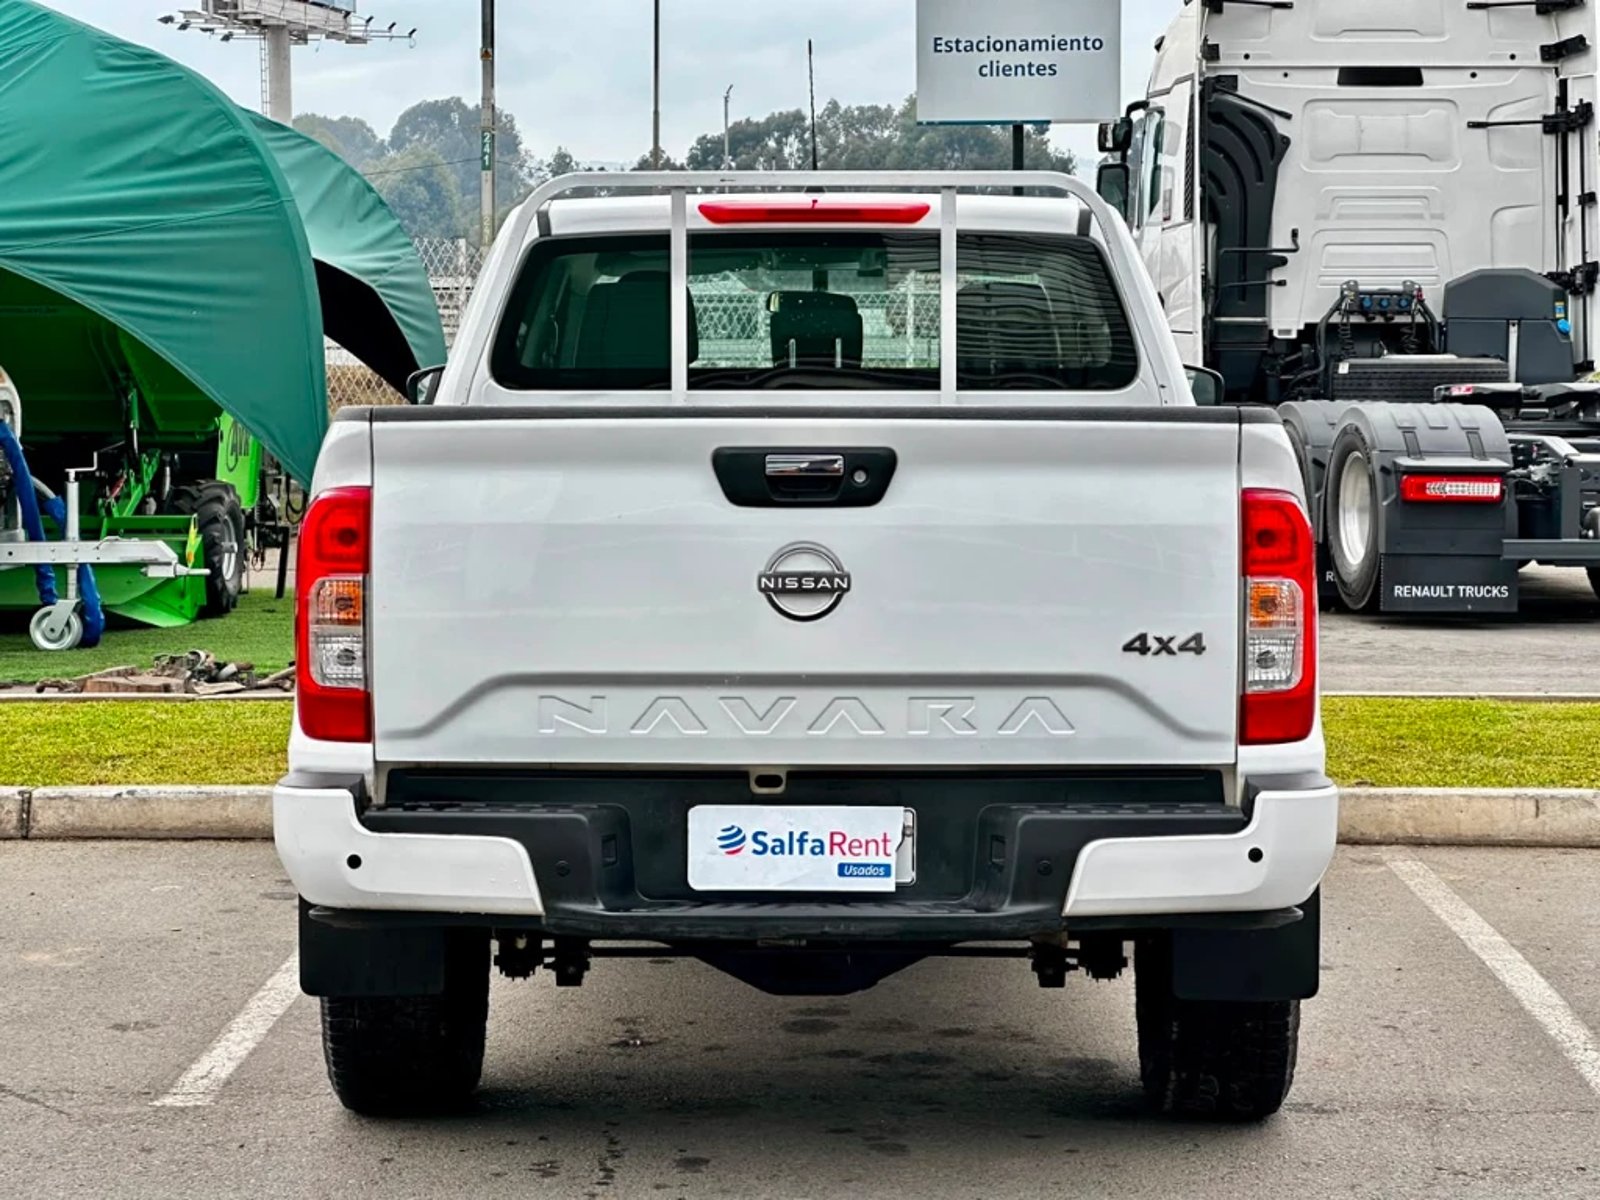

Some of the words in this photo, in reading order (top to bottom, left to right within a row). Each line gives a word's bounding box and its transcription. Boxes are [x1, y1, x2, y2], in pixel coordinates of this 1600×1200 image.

[933, 35, 1104, 53] Estacionamiento
[978, 60, 1057, 77] clientes
[761, 577, 848, 589] NISSAN
[1394, 585, 1454, 598] RENAULT
[1457, 585, 1509, 598] TRUCKS
[1122, 632, 1206, 656] 4x4
[538, 694, 1076, 734] NAVARA
[751, 830, 892, 857] SalfaRent
[844, 865, 885, 877] Usados
